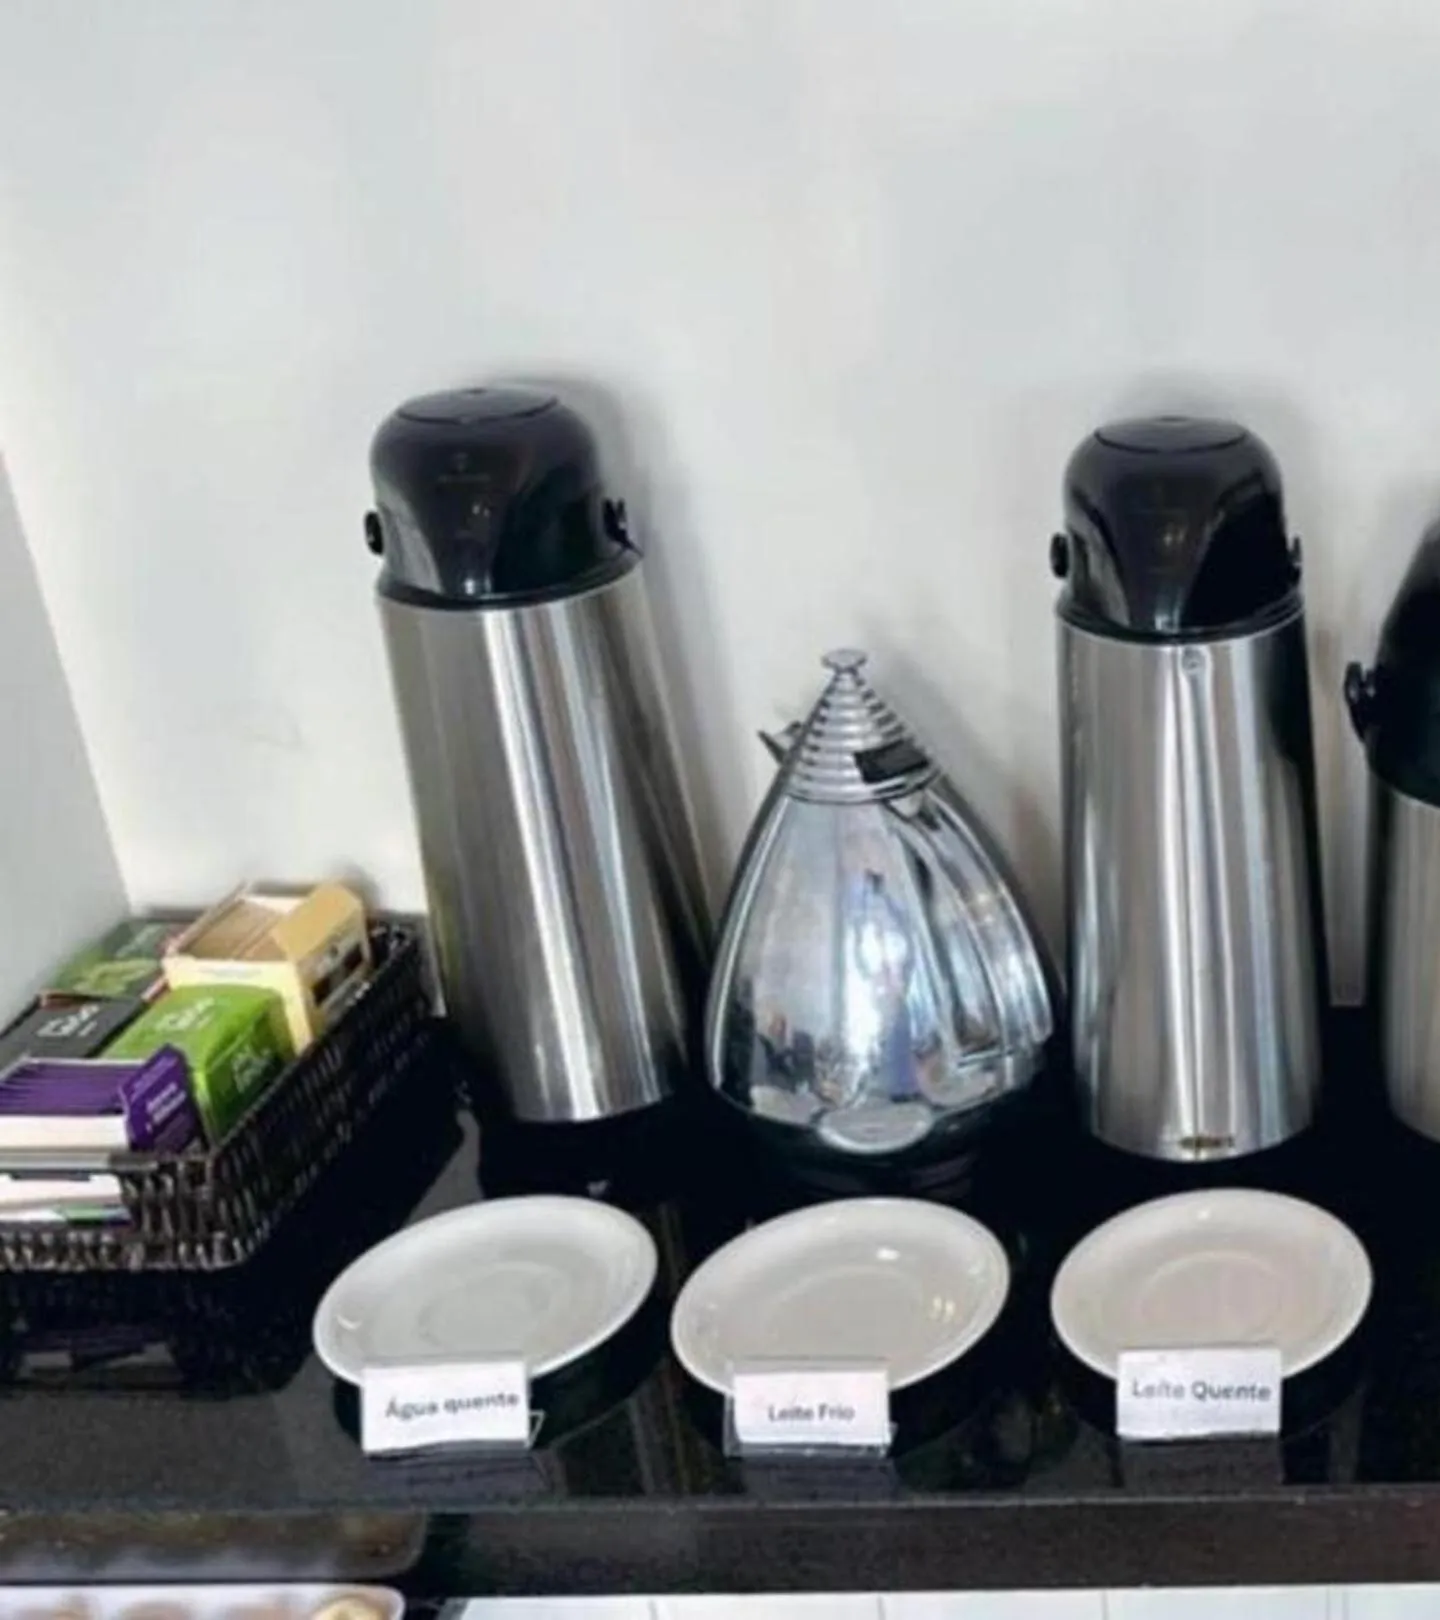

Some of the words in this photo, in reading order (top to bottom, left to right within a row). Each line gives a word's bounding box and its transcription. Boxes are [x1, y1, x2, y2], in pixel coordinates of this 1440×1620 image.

[1132, 1375, 1186, 1399] Leite
[1191, 1380, 1272, 1402] Quente
[443, 1393, 520, 1414] quente
[767, 1402, 815, 1422] Leite
[818, 1402, 856, 1421] Frio
